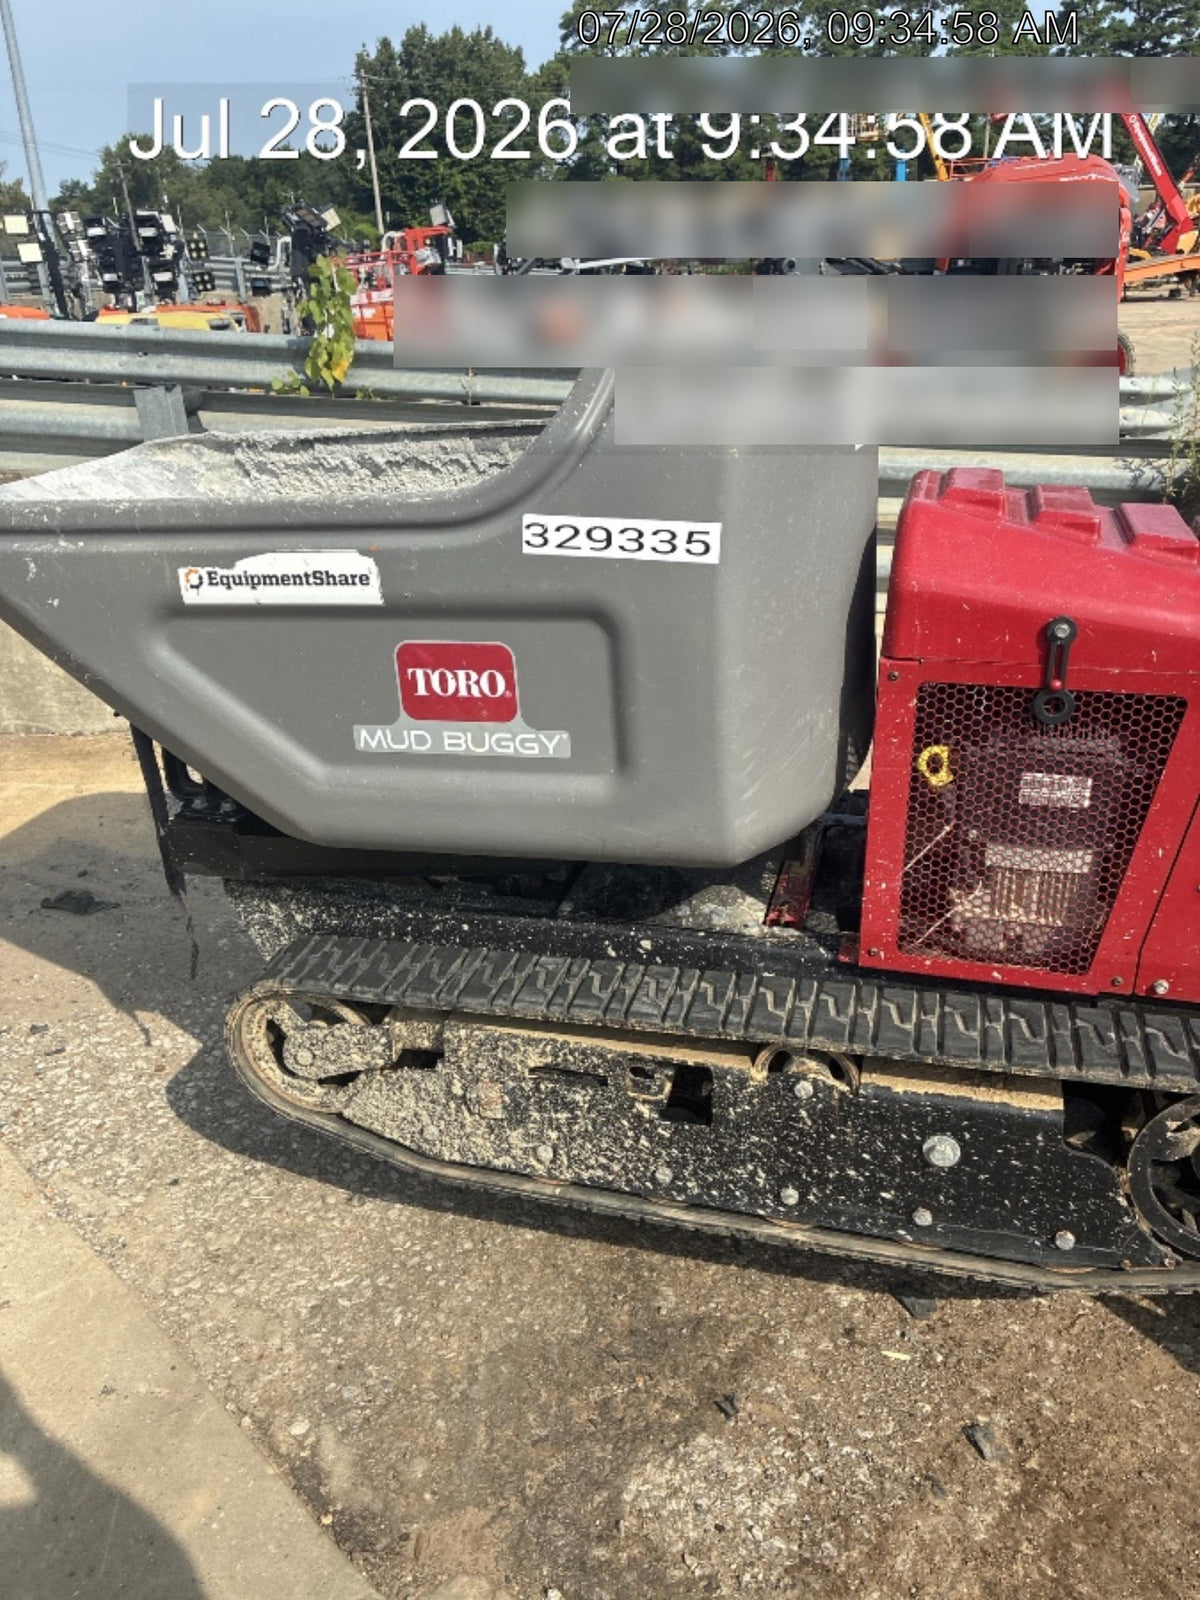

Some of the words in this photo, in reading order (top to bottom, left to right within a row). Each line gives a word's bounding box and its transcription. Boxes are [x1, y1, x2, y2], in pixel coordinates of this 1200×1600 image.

[523, 522, 711, 557] 329335
[206, 570, 371, 590] EquipmentShare
[406, 668, 507, 698] TORO
[359, 728, 432, 751] MUD
[443, 732, 561, 755] BUGGY
